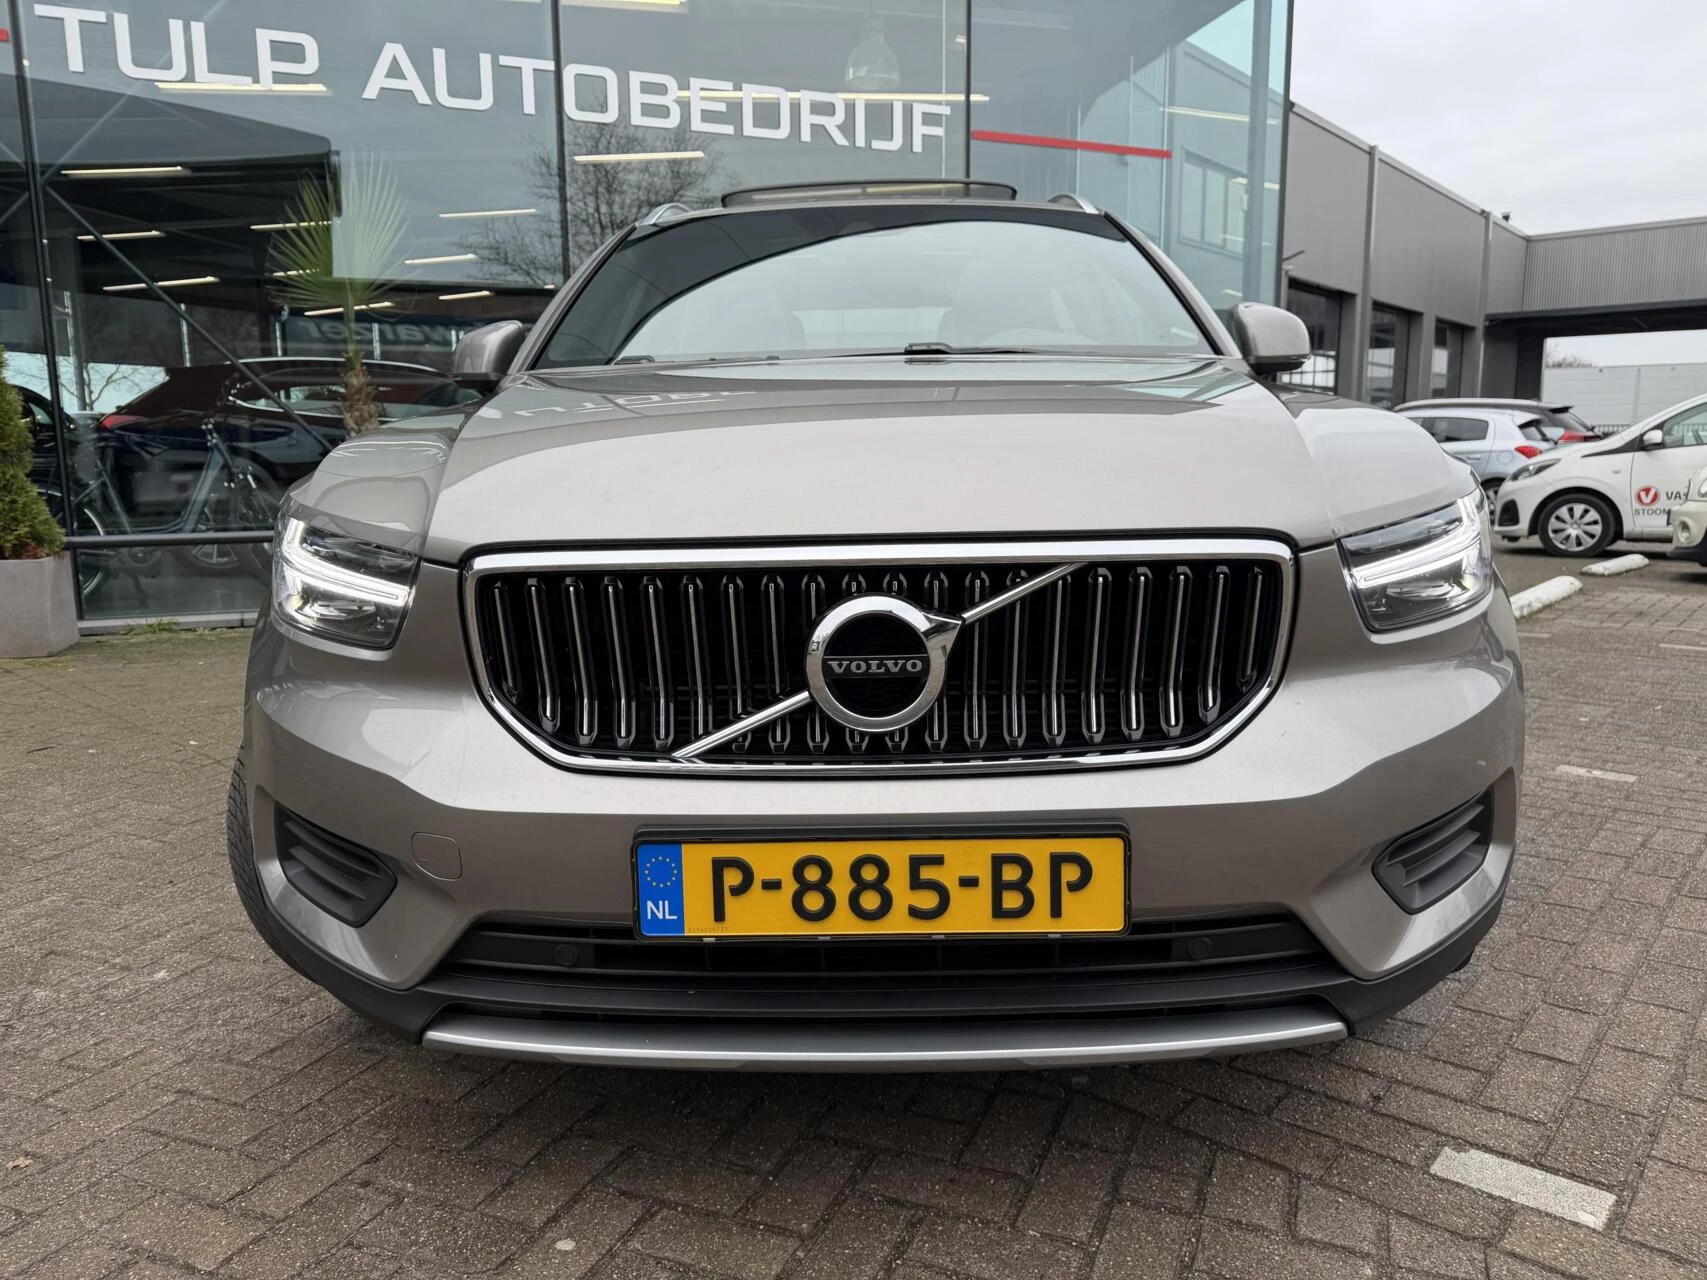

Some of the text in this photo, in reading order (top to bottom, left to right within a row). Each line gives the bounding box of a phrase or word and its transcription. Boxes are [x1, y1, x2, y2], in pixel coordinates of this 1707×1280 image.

[34, 4, 951, 153] TULP AUTOBEDRIJF
[827, 659, 923, 674] VOLVO
[647, 900, 678, 920] NL
[711, 851, 1094, 923] P-885-BP
